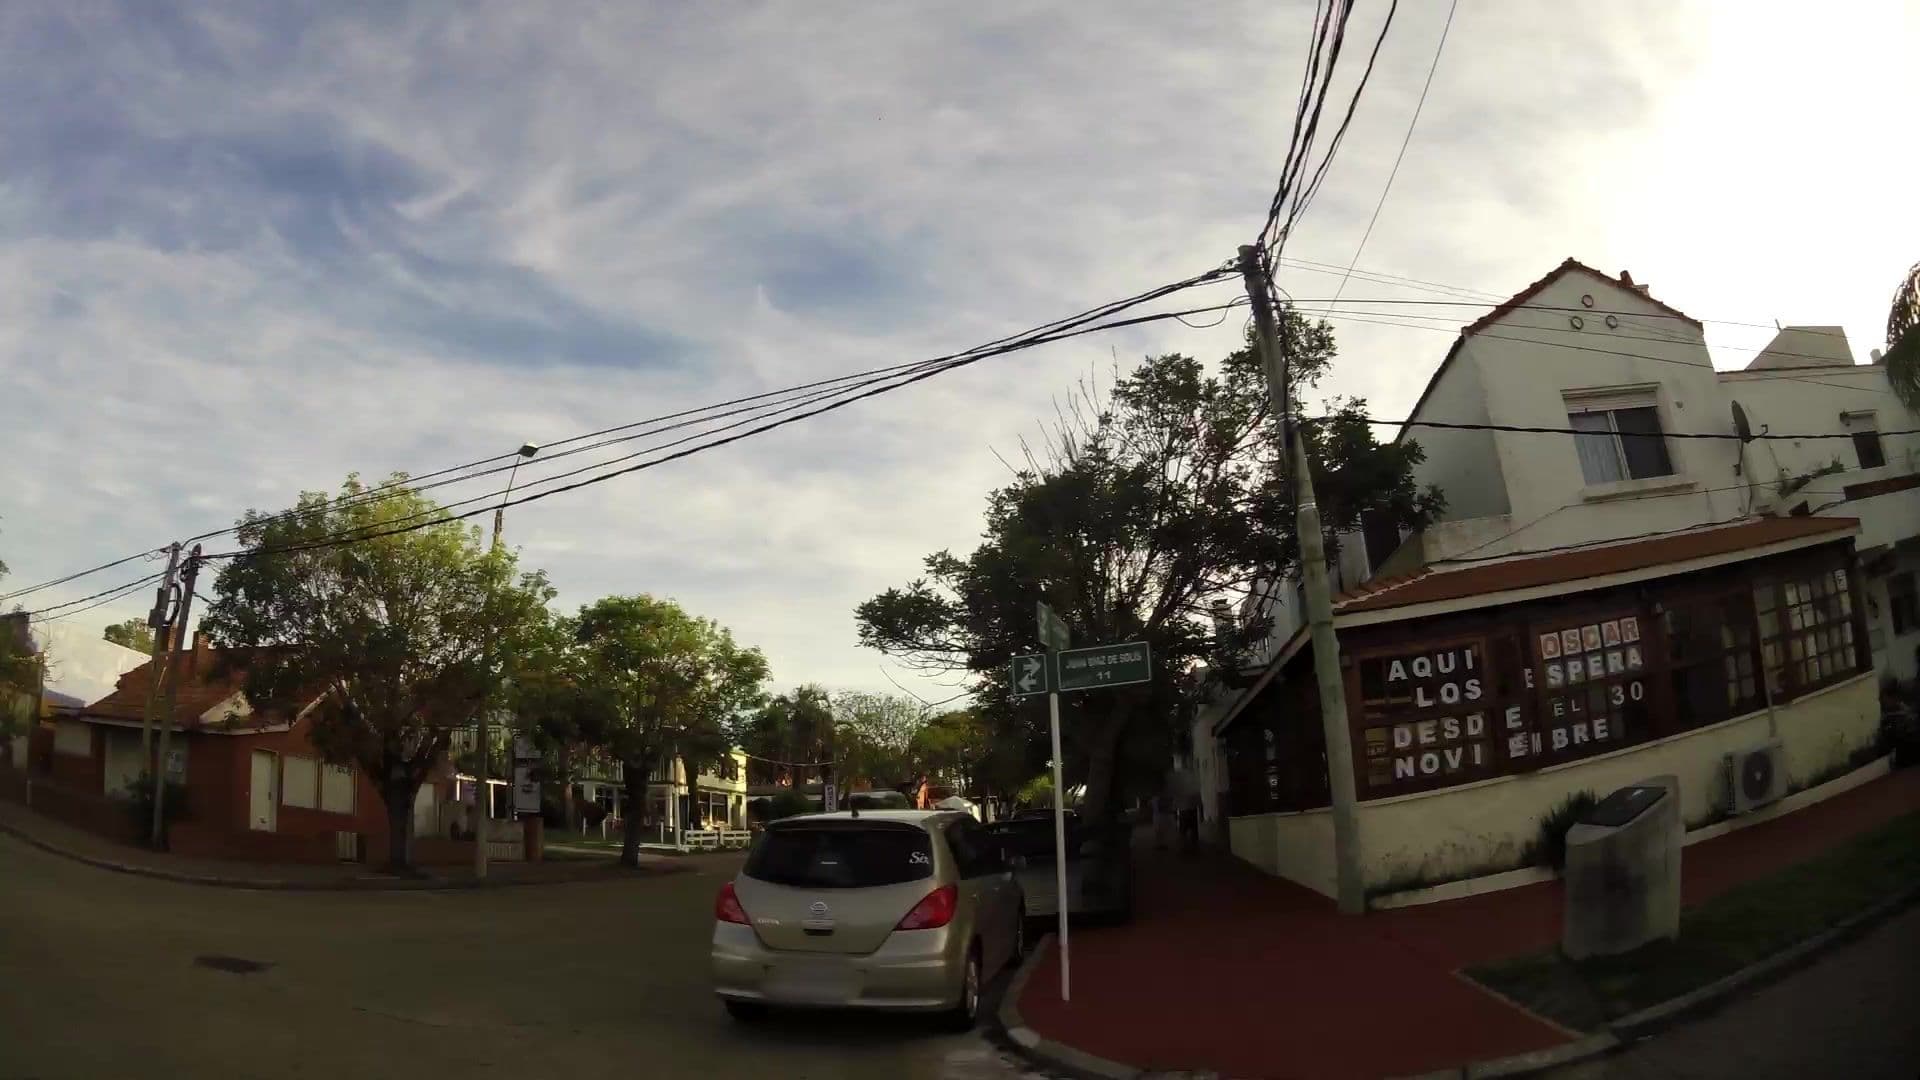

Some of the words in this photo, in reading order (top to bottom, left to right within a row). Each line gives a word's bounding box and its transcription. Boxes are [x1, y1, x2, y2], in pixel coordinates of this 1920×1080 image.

[1387, 649, 1474, 682] AQUI
[1541, 617, 1641, 658] OSCAR
[1096, 670, 1111, 680] 11
[1416, 678, 1482, 708] LOS
[1552, 698, 1581, 718] EL
[1611, 680, 1644, 706] 30
